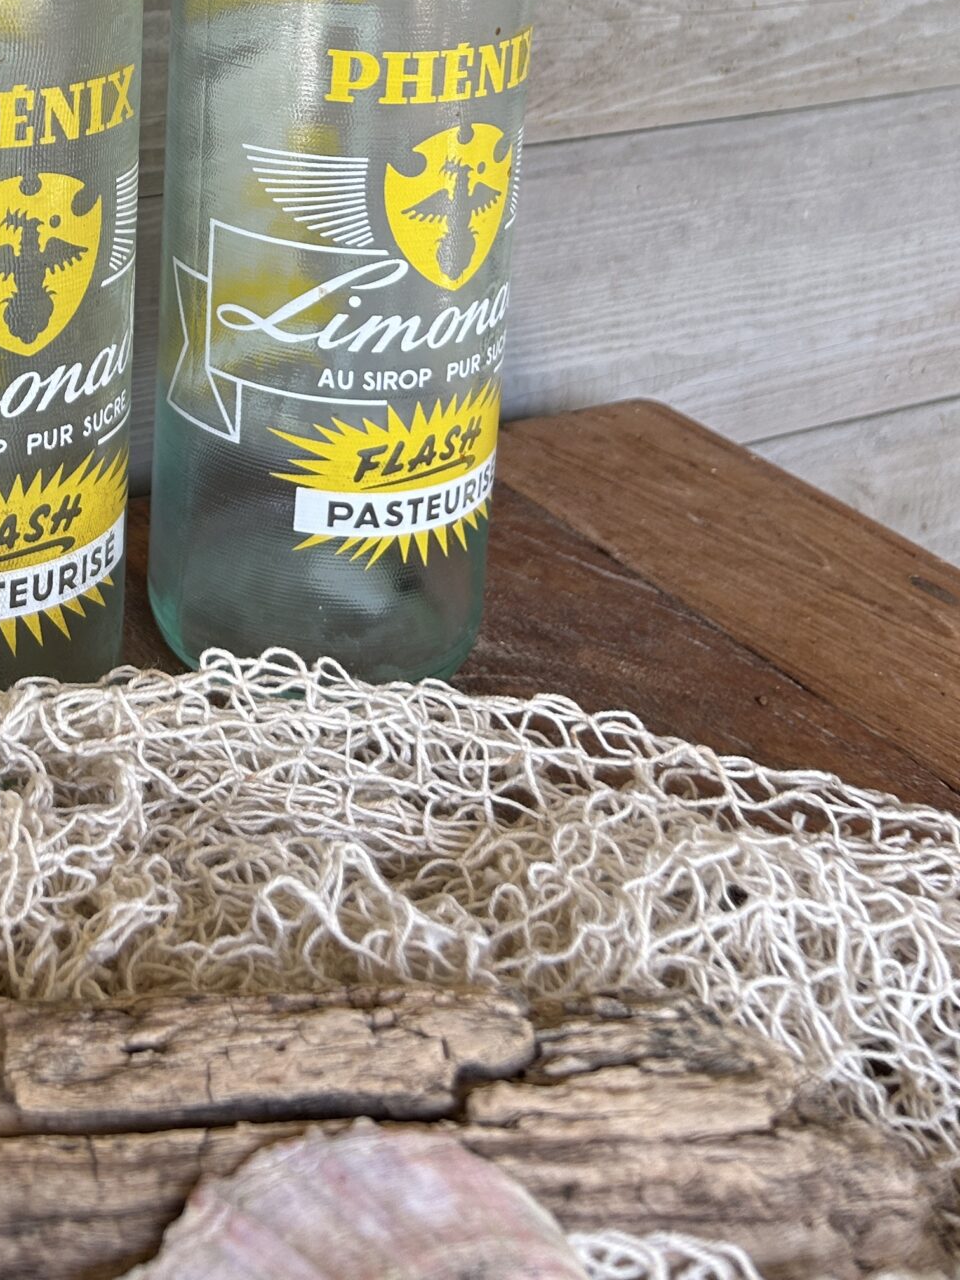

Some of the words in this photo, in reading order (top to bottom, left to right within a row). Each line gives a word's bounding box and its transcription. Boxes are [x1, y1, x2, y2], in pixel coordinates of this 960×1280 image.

[317, 368, 354, 391] AU
[362, 367, 433, 391] SIROP
[446, 353, 482, 383] PUR
[26, 423, 74, 456] PUR
[82, 388, 127, 437] SUCRE
[353, 415, 482, 484] FLASH
